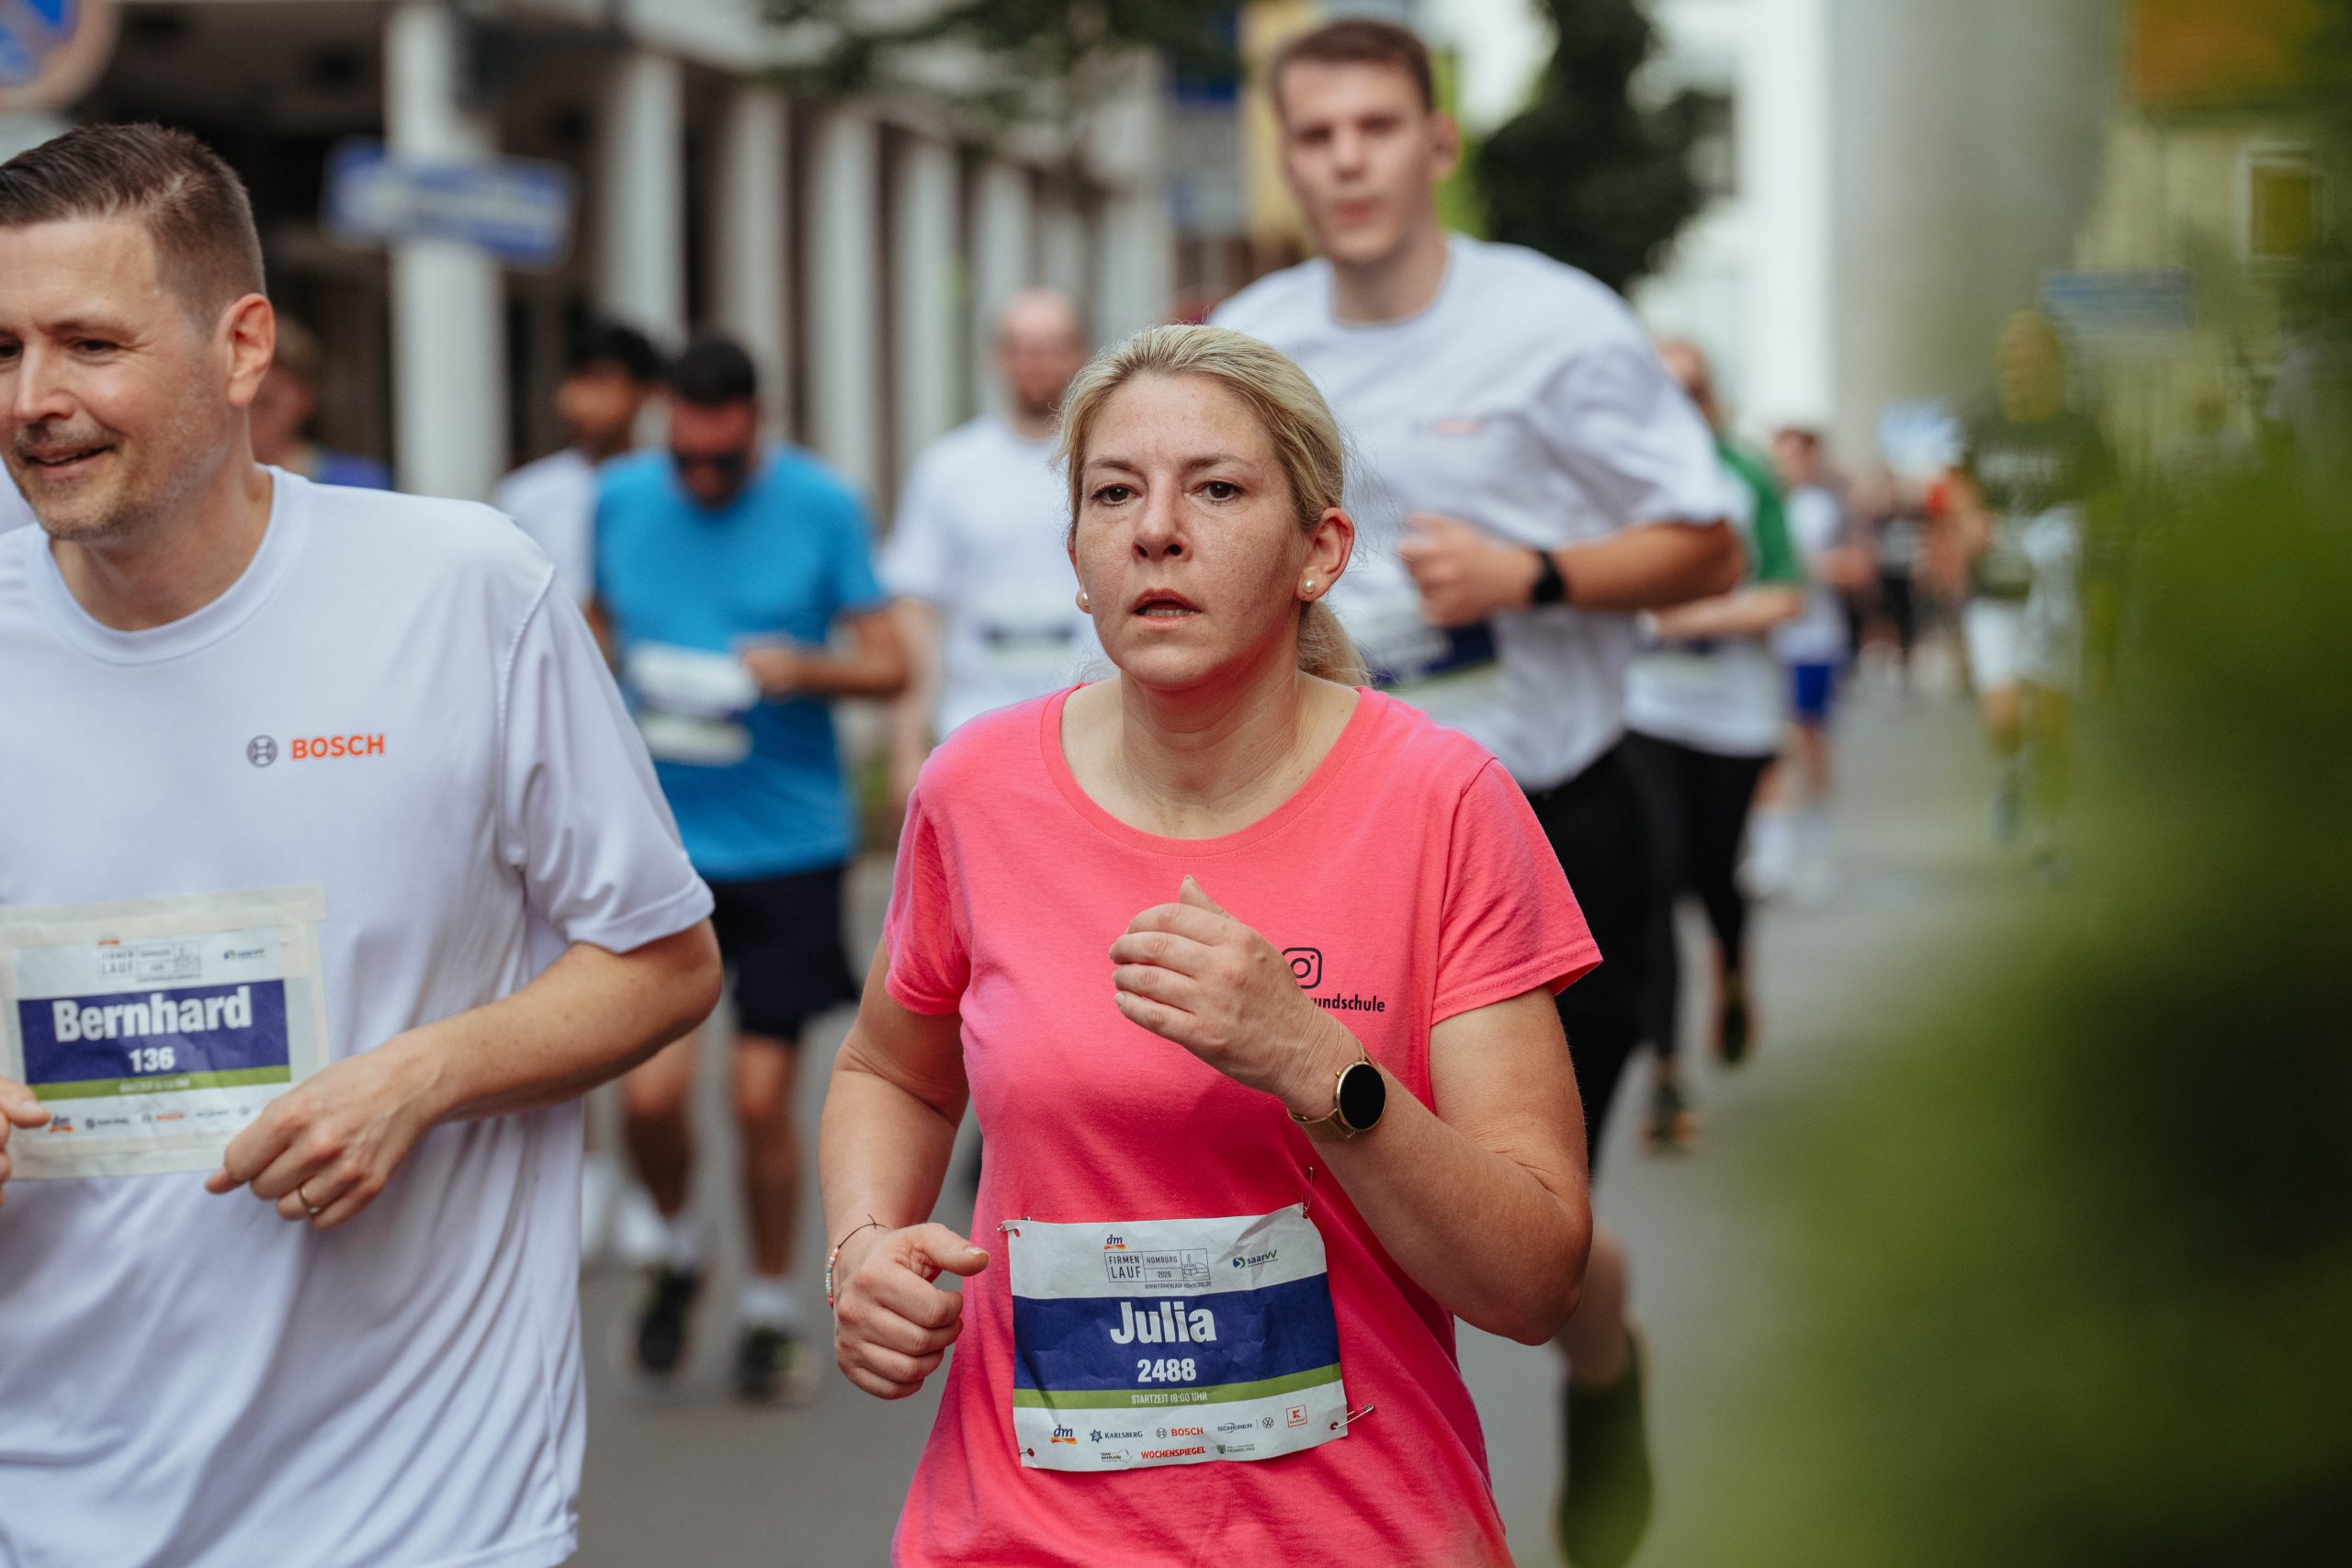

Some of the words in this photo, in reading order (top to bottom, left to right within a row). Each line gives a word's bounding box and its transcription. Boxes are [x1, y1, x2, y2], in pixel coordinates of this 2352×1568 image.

[291, 734, 385, 761] BOSCH
[1310, 993, 1385, 1012] undschule
[51, 985, 253, 1043] Bernhard
[129, 1046, 176, 1073] 136
[1106, 1234, 1123, 1245] dm
[1109, 1255, 1140, 1264] FIRMEN
[1146, 1256, 1178, 1264] HOMBURG
[1111, 1267, 1142, 1279] LAUF
[1110, 1301, 1217, 1345] Julia
[1136, 1358, 1196, 1382] 2488
[1131, 1393, 1169, 1404] STARTZEIT
[1170, 1393, 1191, 1404] 18:00
[1191, 1392, 1208, 1402] UHR
[1053, 1425, 1073, 1438] dm
[1104, 1430, 1143, 1439] KARLSBERG
[1171, 1427, 1204, 1437] BOSCH
[1141, 1447, 1205, 1460] WOCHENSPIEGEL
